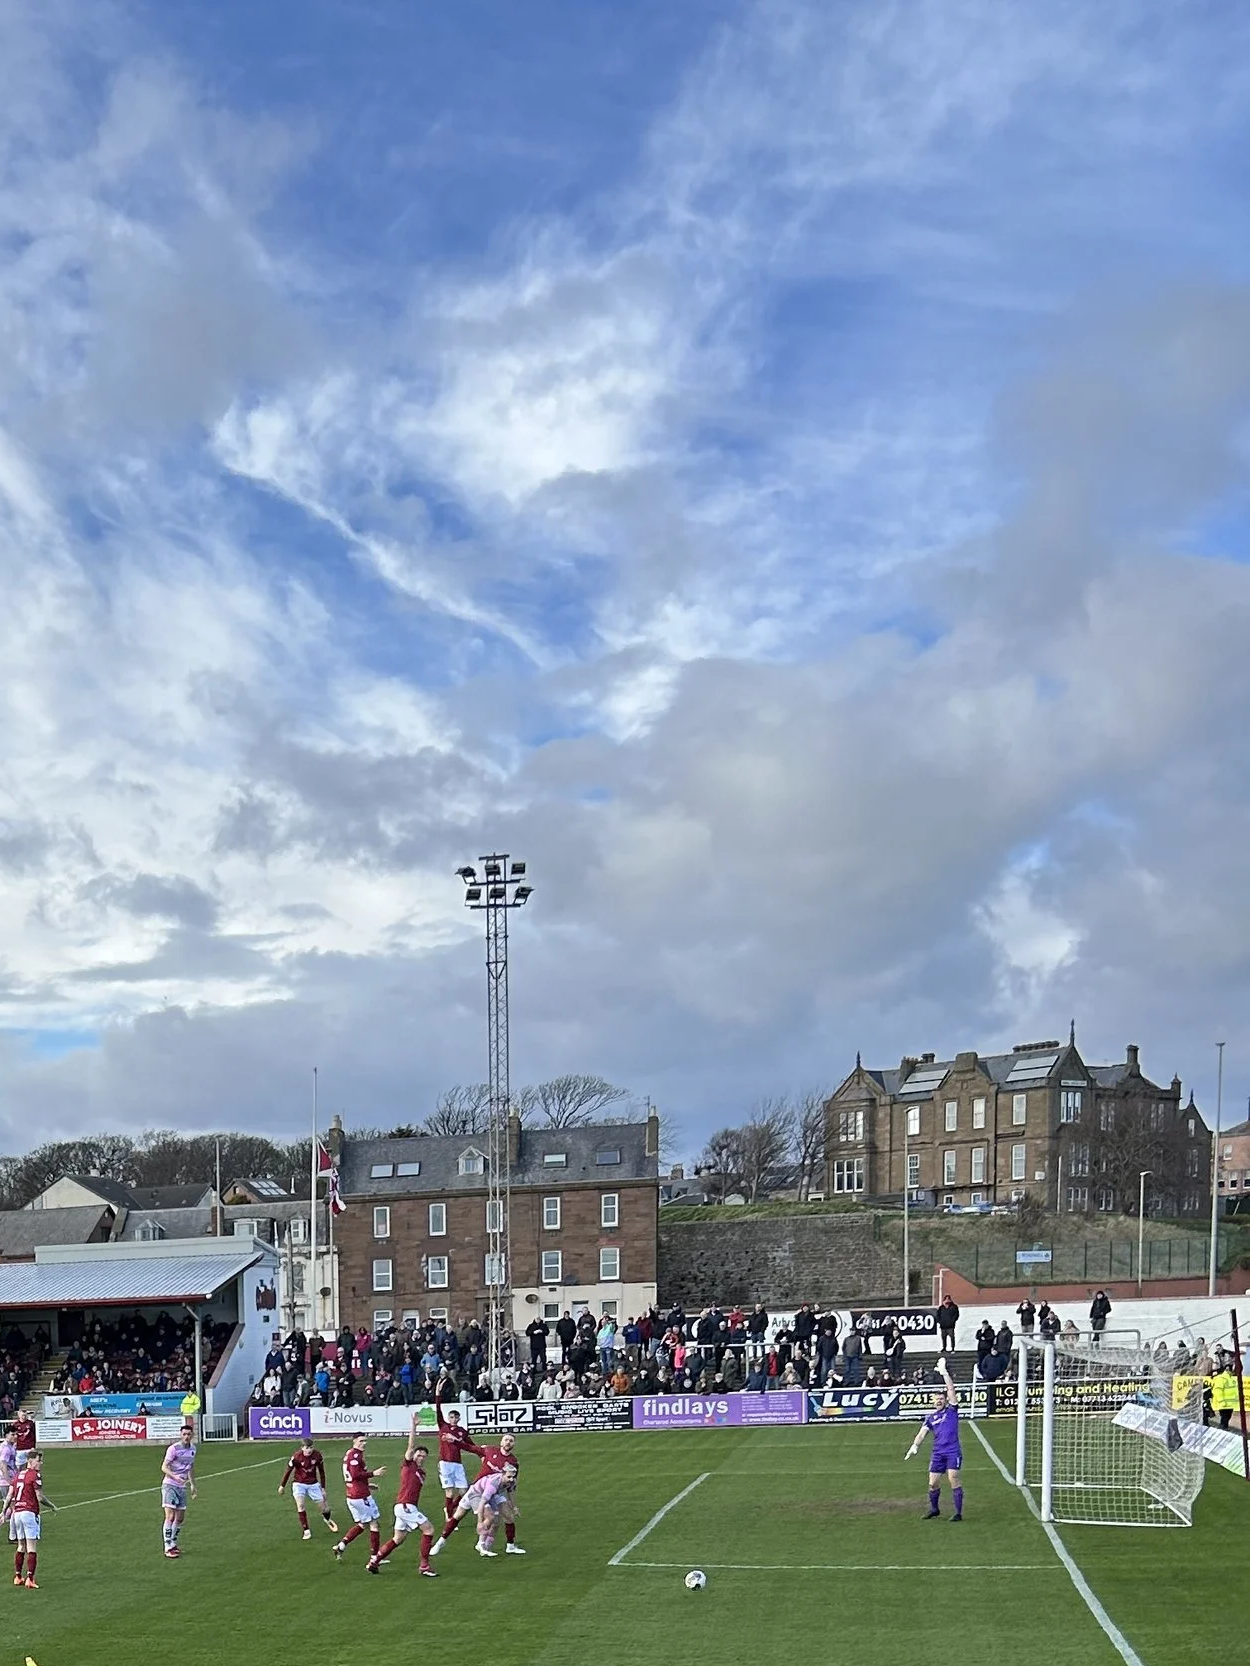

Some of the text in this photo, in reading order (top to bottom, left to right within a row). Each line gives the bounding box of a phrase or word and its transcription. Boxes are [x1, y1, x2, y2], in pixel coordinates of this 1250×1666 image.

[996, 1387, 1015, 1397] ILG
[1075, 1384, 1100, 1394] and
[1103, 1383, 1151, 1395] Heating
[643, 1398, 728, 1417] findlays
[822, 1392, 898, 1410] Lucy
[259, 1411, 302, 1429] cinch
[324, 1410, 373, 1424] i-Novus
[73, 1423, 94, 1437] R.S.
[96, 1419, 145, 1434] JOINERY
